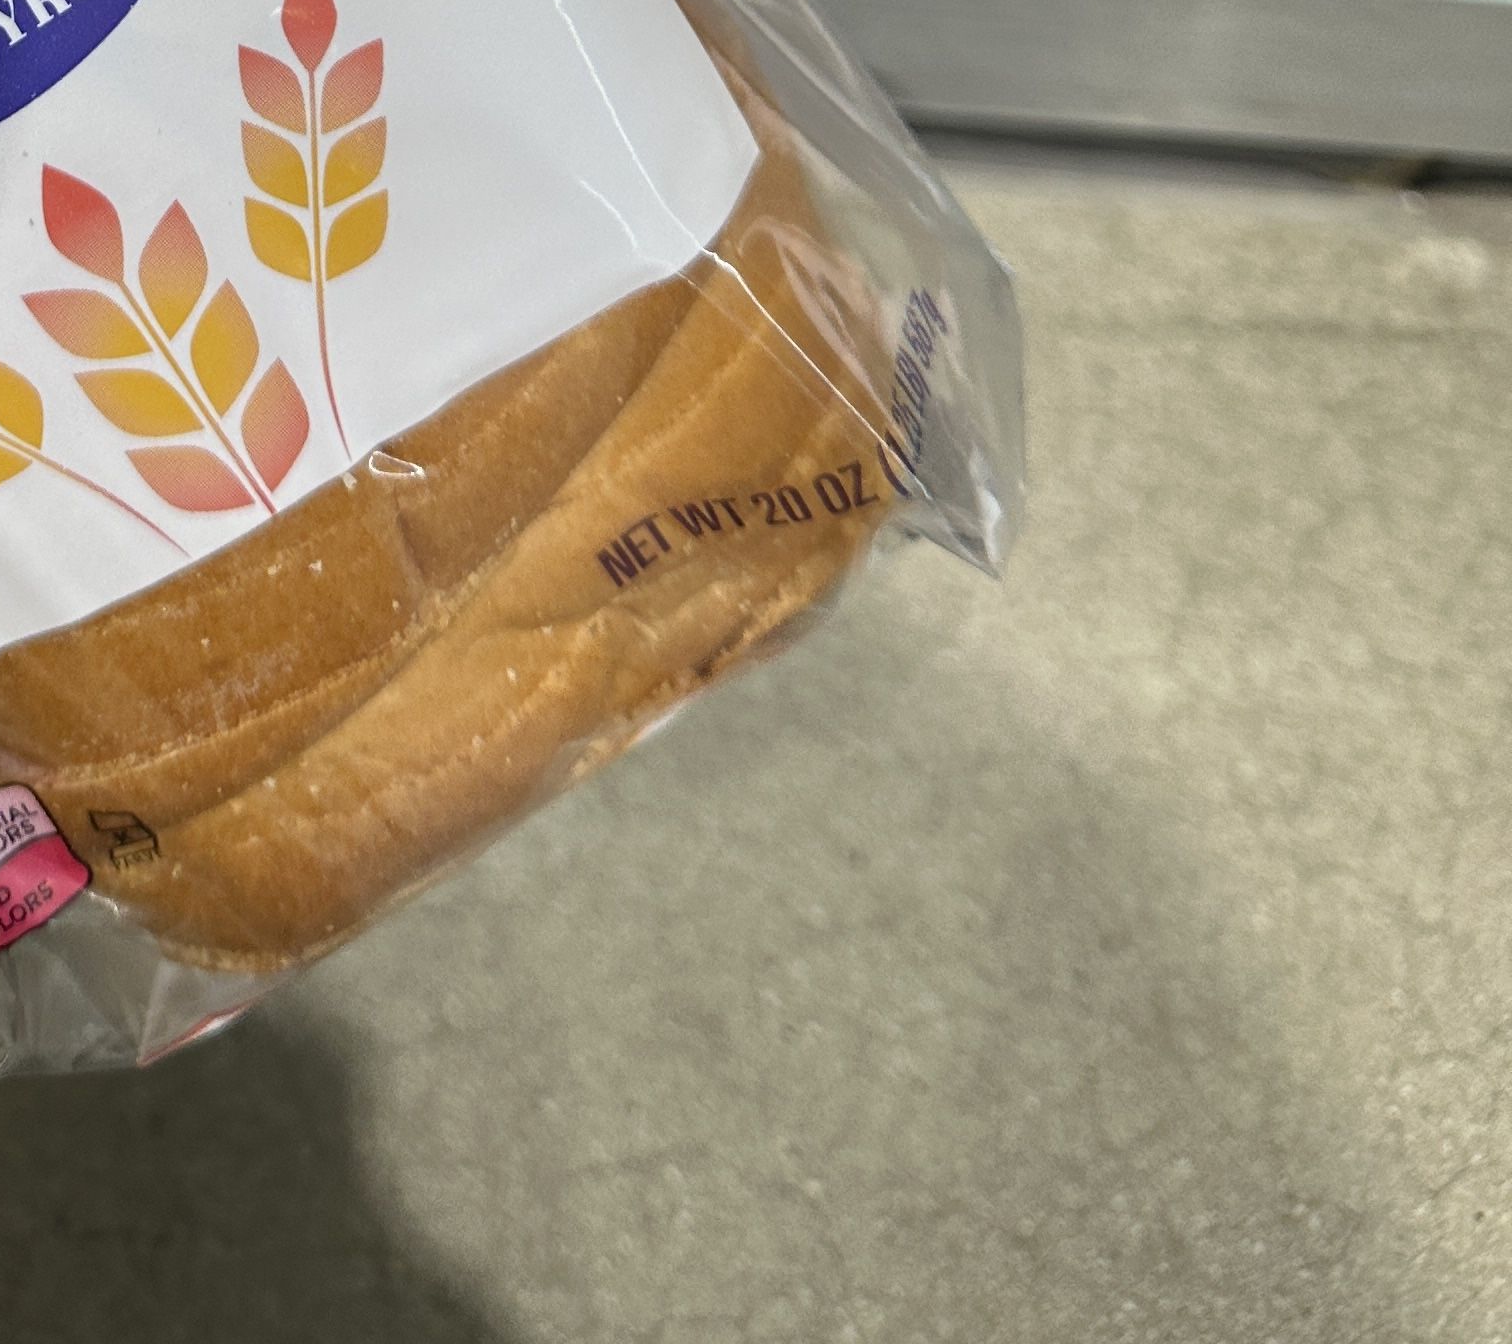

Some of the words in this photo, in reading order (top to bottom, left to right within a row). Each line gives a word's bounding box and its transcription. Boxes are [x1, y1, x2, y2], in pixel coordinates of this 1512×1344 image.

[596, 515, 673, 587] NET
[668, 494, 745, 537] WT
[751, 485, 813, 527] 20
[813, 458, 881, 515] OZ
